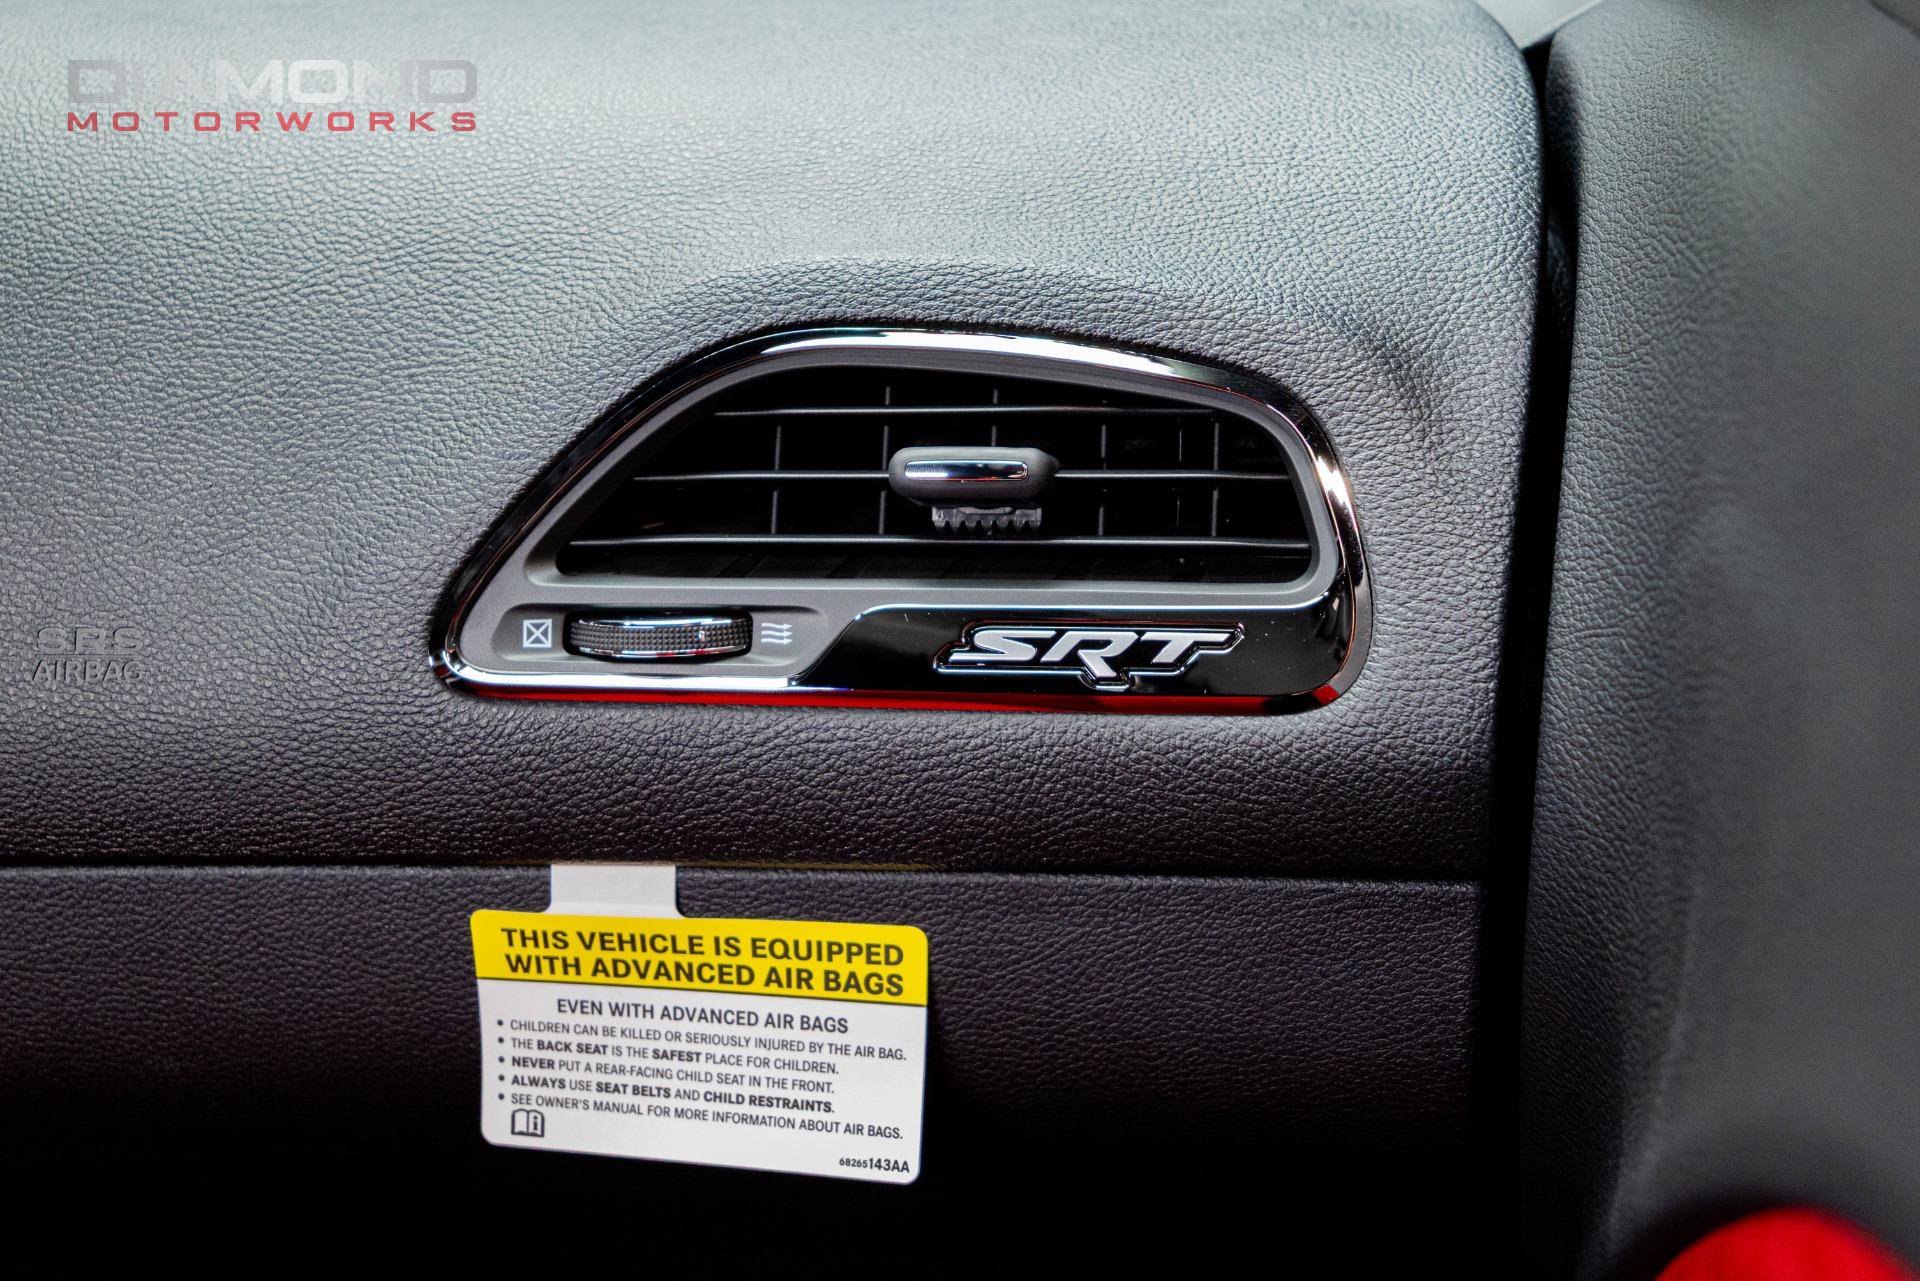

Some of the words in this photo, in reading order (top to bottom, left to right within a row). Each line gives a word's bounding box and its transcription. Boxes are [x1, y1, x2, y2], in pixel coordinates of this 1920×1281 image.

[37, 626, 144, 653] SRS
[949, 629, 1231, 678] SRT
[32, 659, 143, 682] AIRBAG
[501, 928, 569, 950] THIS
[576, 931, 705, 955] VEHICLE
[714, 936, 741, 957] IS
[751, 937, 904, 966] EQUIPPED
[505, 954, 581, 976] WITH
[591, 957, 755, 986] ADVANCED
[764, 966, 814, 990] AIR
[824, 969, 903, 997] BAGS
[557, 998, 603, 1016] EVEN
[608, 1001, 654, 1019] WITH
[660, 1005, 759, 1027] ADVANCED
[764, 1012, 794, 1030] AIR
[800, 1015, 848, 1034] BAGS
[510, 1019, 570, 1034] CHILDREN
[573, 1024, 598, 1036] CAN
[602, 1025, 617, 1038] BE
[620, 1027, 662, 1041] KILLED
[664, 1030, 682, 1042] OR
[685, 1032, 751, 1048] SERIOUSLY
[755, 1037, 806, 1052] INJURED
[809, 1041, 824, 1054] BY
[827, 1043, 851, 1056] THE
[854, 1045, 875, 1058] AIR
[878, 1047, 906, 1061] BAG.
[511, 1037, 533, 1050] THE
[537, 1039, 573, 1053] BACK
[576, 1042, 608, 1055] SEAT
[611, 1045, 623, 1057] IS
[626, 1046, 648, 1059] THE
[652, 1048, 702, 1063] SAFEST
[705, 1052, 743, 1067] PLACE
[746, 1056, 771, 1069] FOR
[773, 1058, 839, 1075] CHILDREN.
[511, 1074, 566, 1090] ALWAYS
[569, 1079, 593, 1092] USE
[595, 1081, 629, 1095] SEAT
[632, 1084, 671, 1099] BELTS
[674, 1088, 700, 1101] AND
[703, 1091, 745, 1105] CHILD
[748, 1094, 834, 1113] RESTRAINTS.
[512, 1056, 555, 1070] NEVER
[558, 1059, 581, 1072] PUT
[584, 1062, 592, 1073] A
[595, 1062, 673, 1080] REAR-FACING
[676, 1069, 713, 1083] CHILD
[716, 1072, 746, 1086] SEAT
[749, 1075, 761, 1087] IN
[765, 1076, 788, 1090] THE
[791, 1079, 834, 1094] FRONT.
[511, 1093, 532, 1106] SEE
[535, 1095, 590, 1111] OWNER'S
[593, 1100, 643, 1115] MANUAL
[647, 1104, 671, 1118] FOR
[674, 1107, 709, 1121] MORE
[712, 1111, 796, 1129] INFORMATION
[799, 1119, 841, 1133] ABOUT
[843, 1123, 864, 1136] AIR
[867, 1125, 903, 1139] BAGS.
